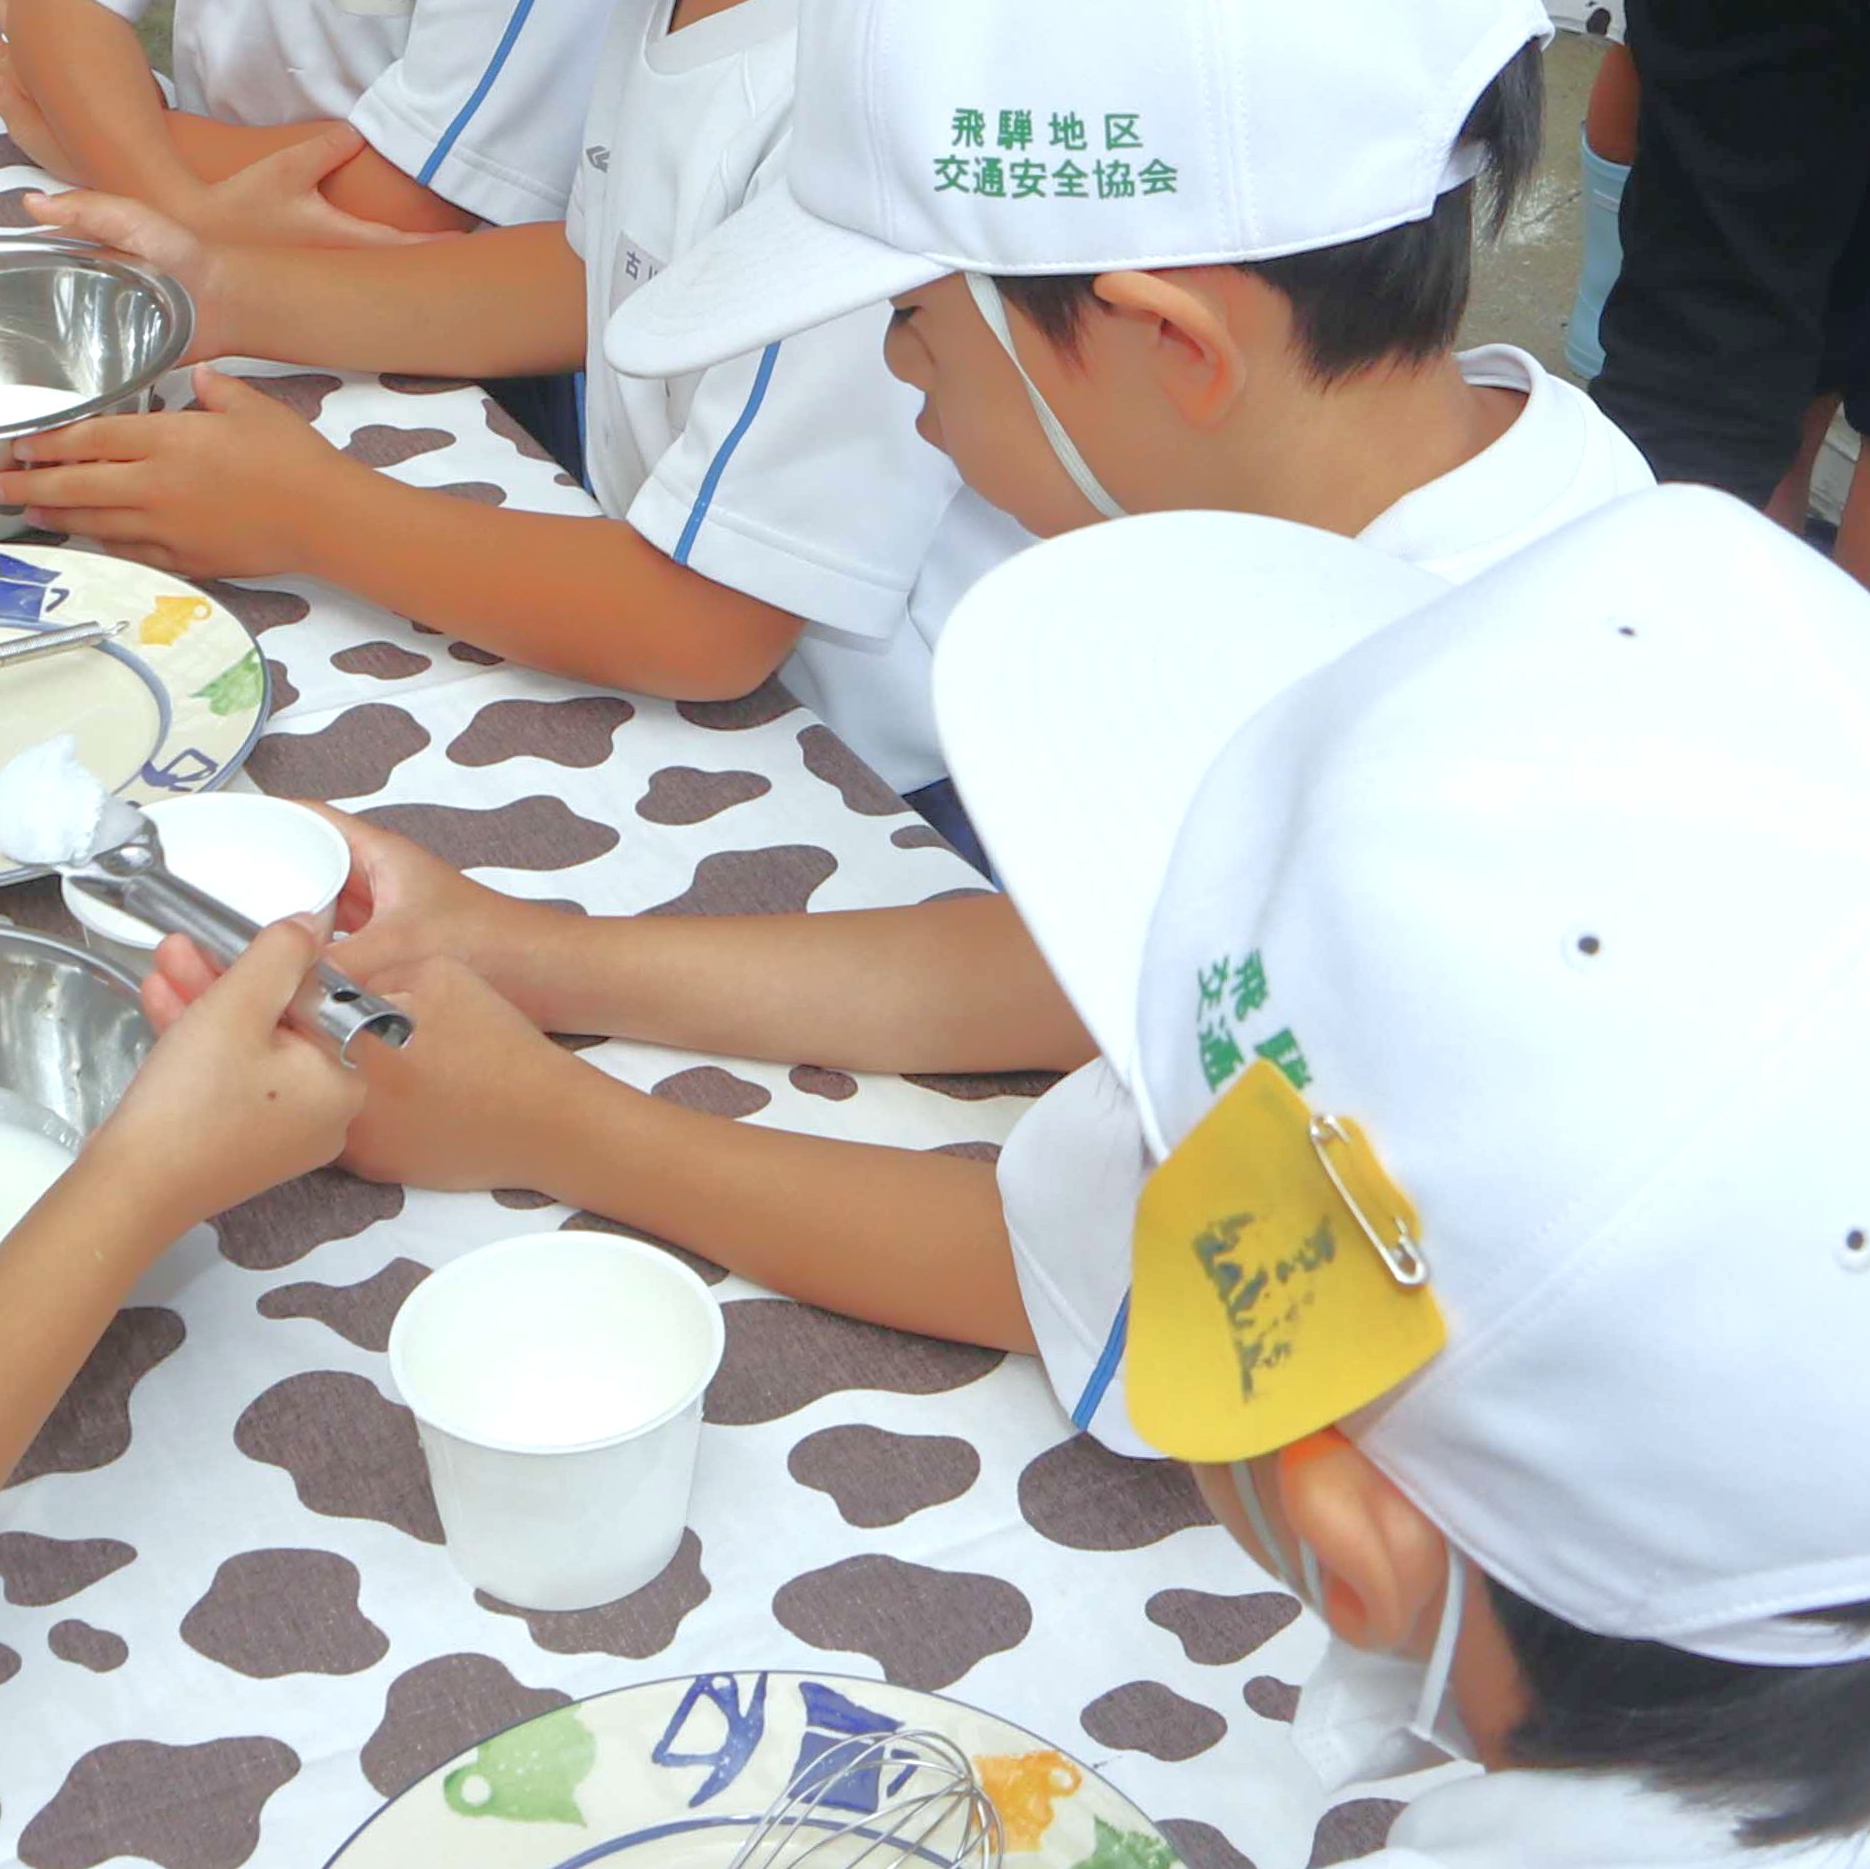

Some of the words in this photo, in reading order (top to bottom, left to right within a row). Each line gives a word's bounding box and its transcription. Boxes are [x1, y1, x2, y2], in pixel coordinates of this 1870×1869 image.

[950, 107, 1145, 151] 飛騨地区
[933, 154, 1179, 200] 交通安全協会
